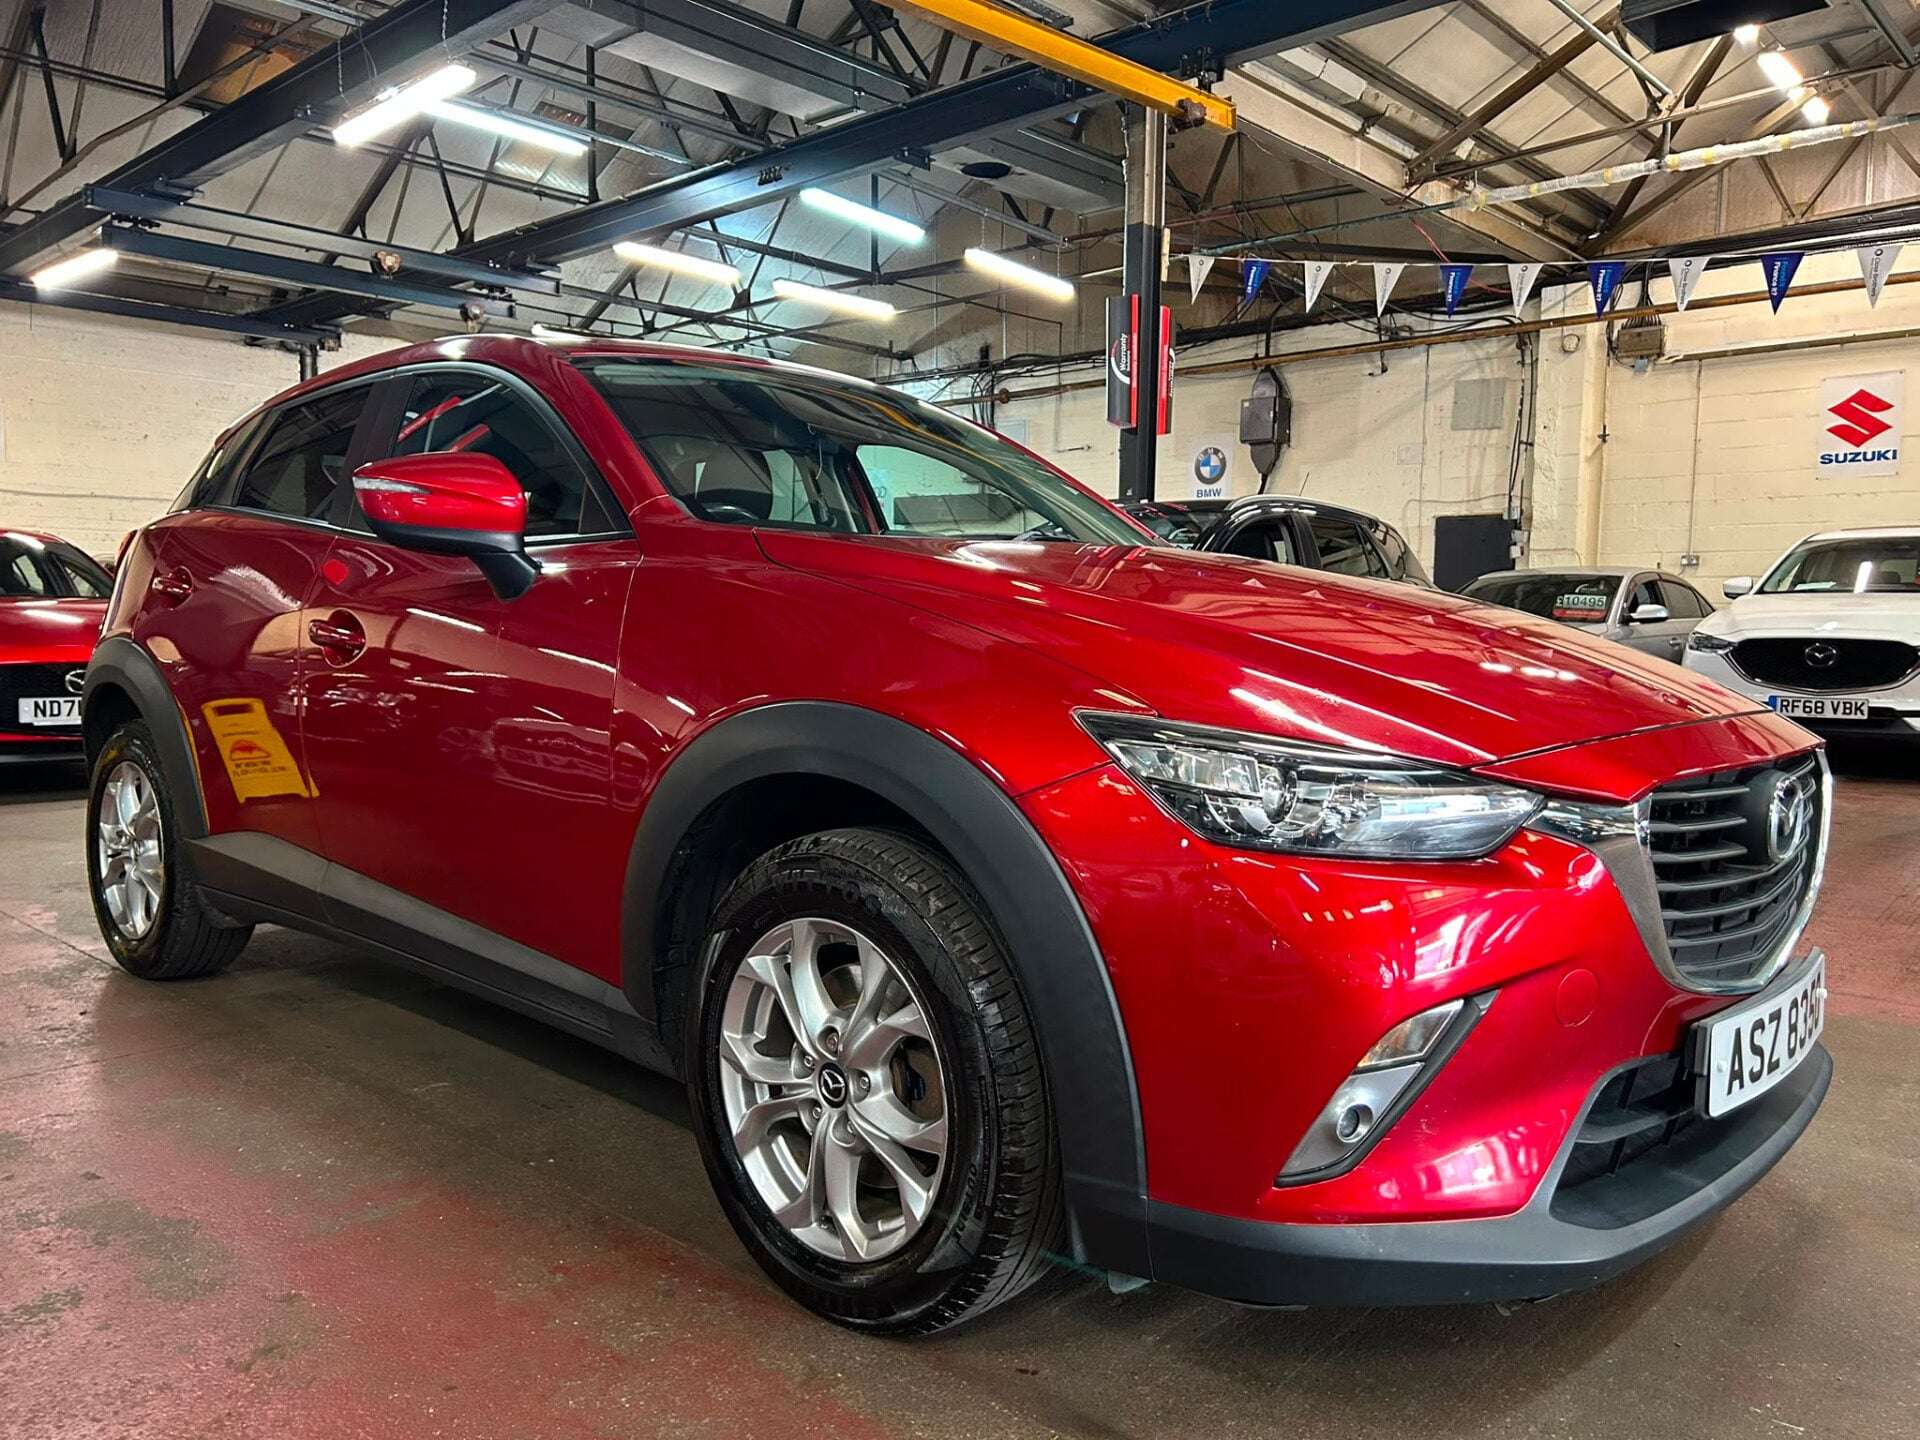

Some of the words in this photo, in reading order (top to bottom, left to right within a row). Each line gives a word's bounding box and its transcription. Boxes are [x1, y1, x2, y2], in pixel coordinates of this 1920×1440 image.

[1771, 261, 1781, 287] Finance
[1770, 287, 1778, 296] it?
[1120, 333, 1128, 371] Warranty
[1819, 449, 1897, 464] SUZUKI
[1196, 488, 1222, 498] BMW
[1780, 698, 1825, 714] RF68
[1831, 700, 1865, 716] VBK
[1726, 1007, 1782, 1096] ASZ
